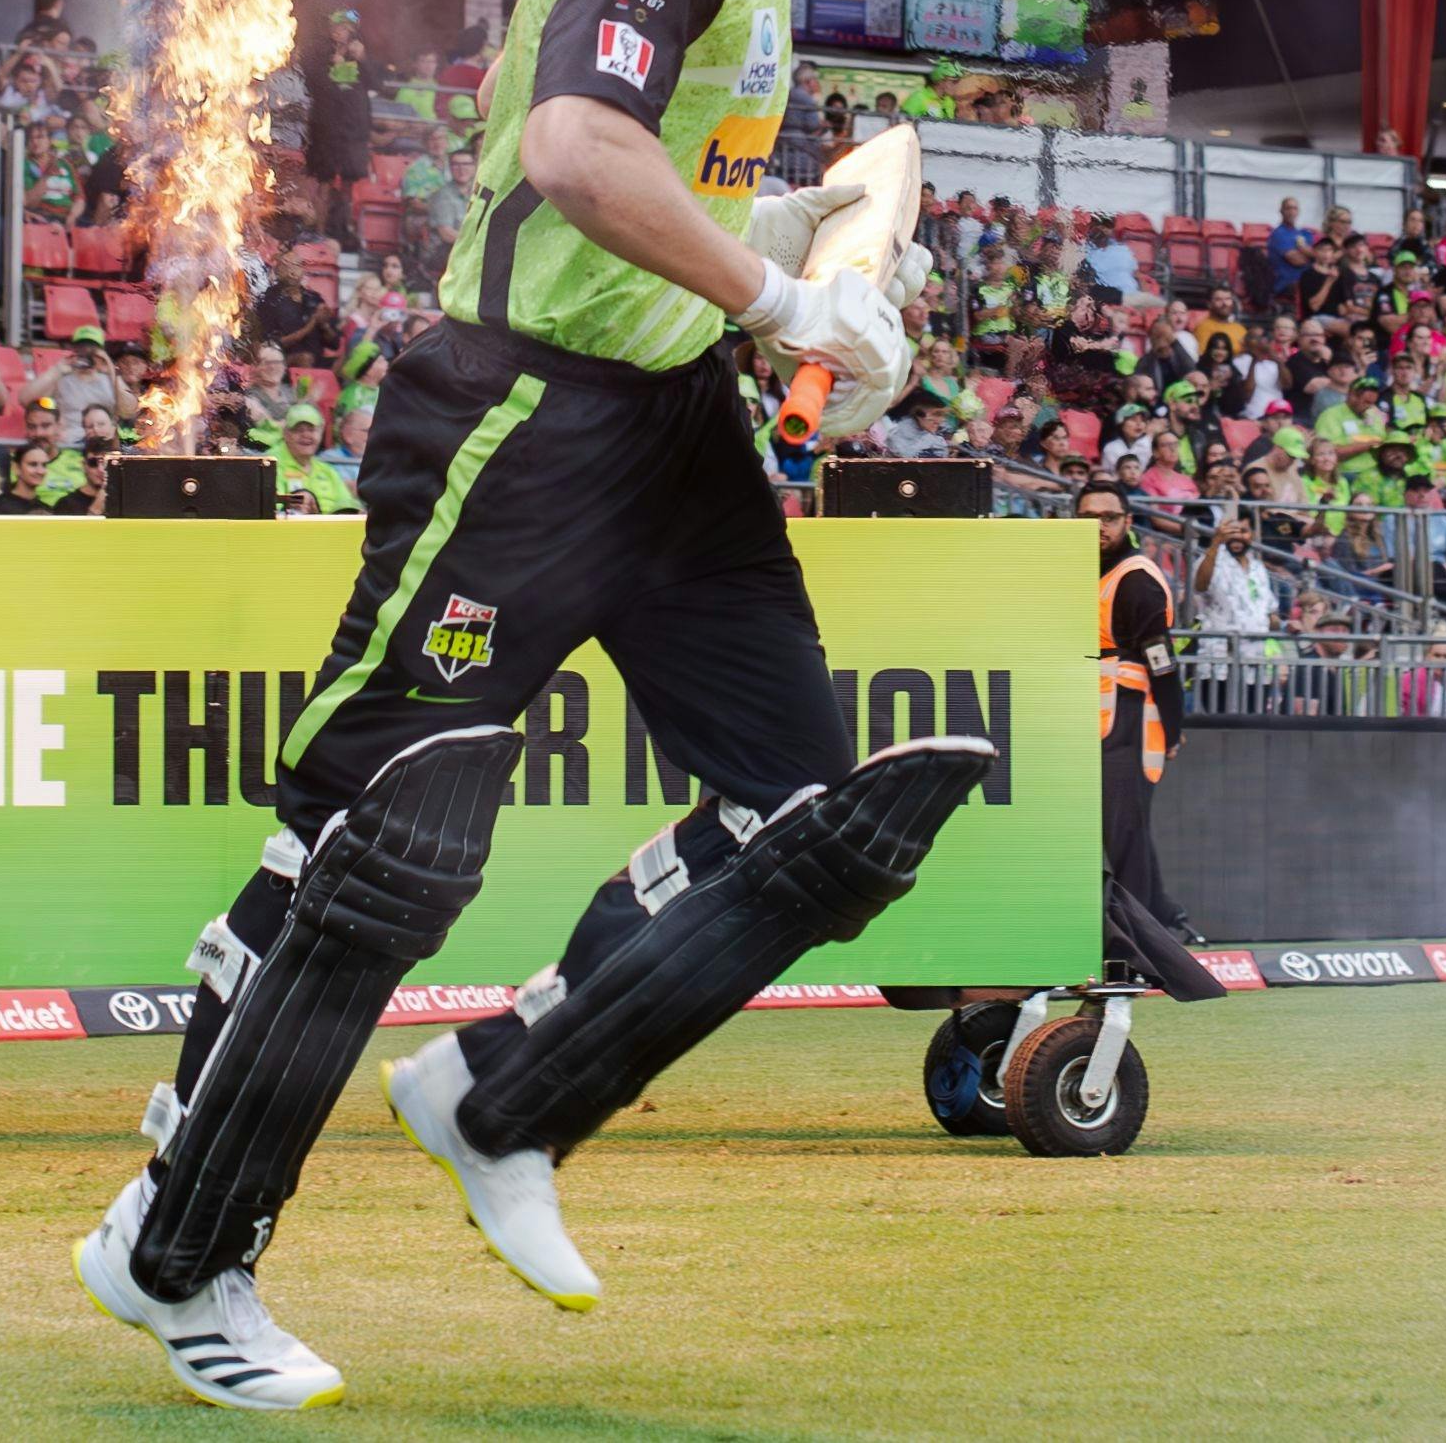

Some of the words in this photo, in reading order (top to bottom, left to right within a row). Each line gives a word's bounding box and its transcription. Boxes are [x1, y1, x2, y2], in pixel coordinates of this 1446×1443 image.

[608, 59, 640, 82] KFC
[454, 602, 486, 618] KFC
[426, 625, 490, 663] BBL
[97, 669, 590, 807] THUR
[1316, 952, 1414, 977] TOYOTA
[398, 986, 429, 1012] for
[431, 985, 514, 1010] Cricket
